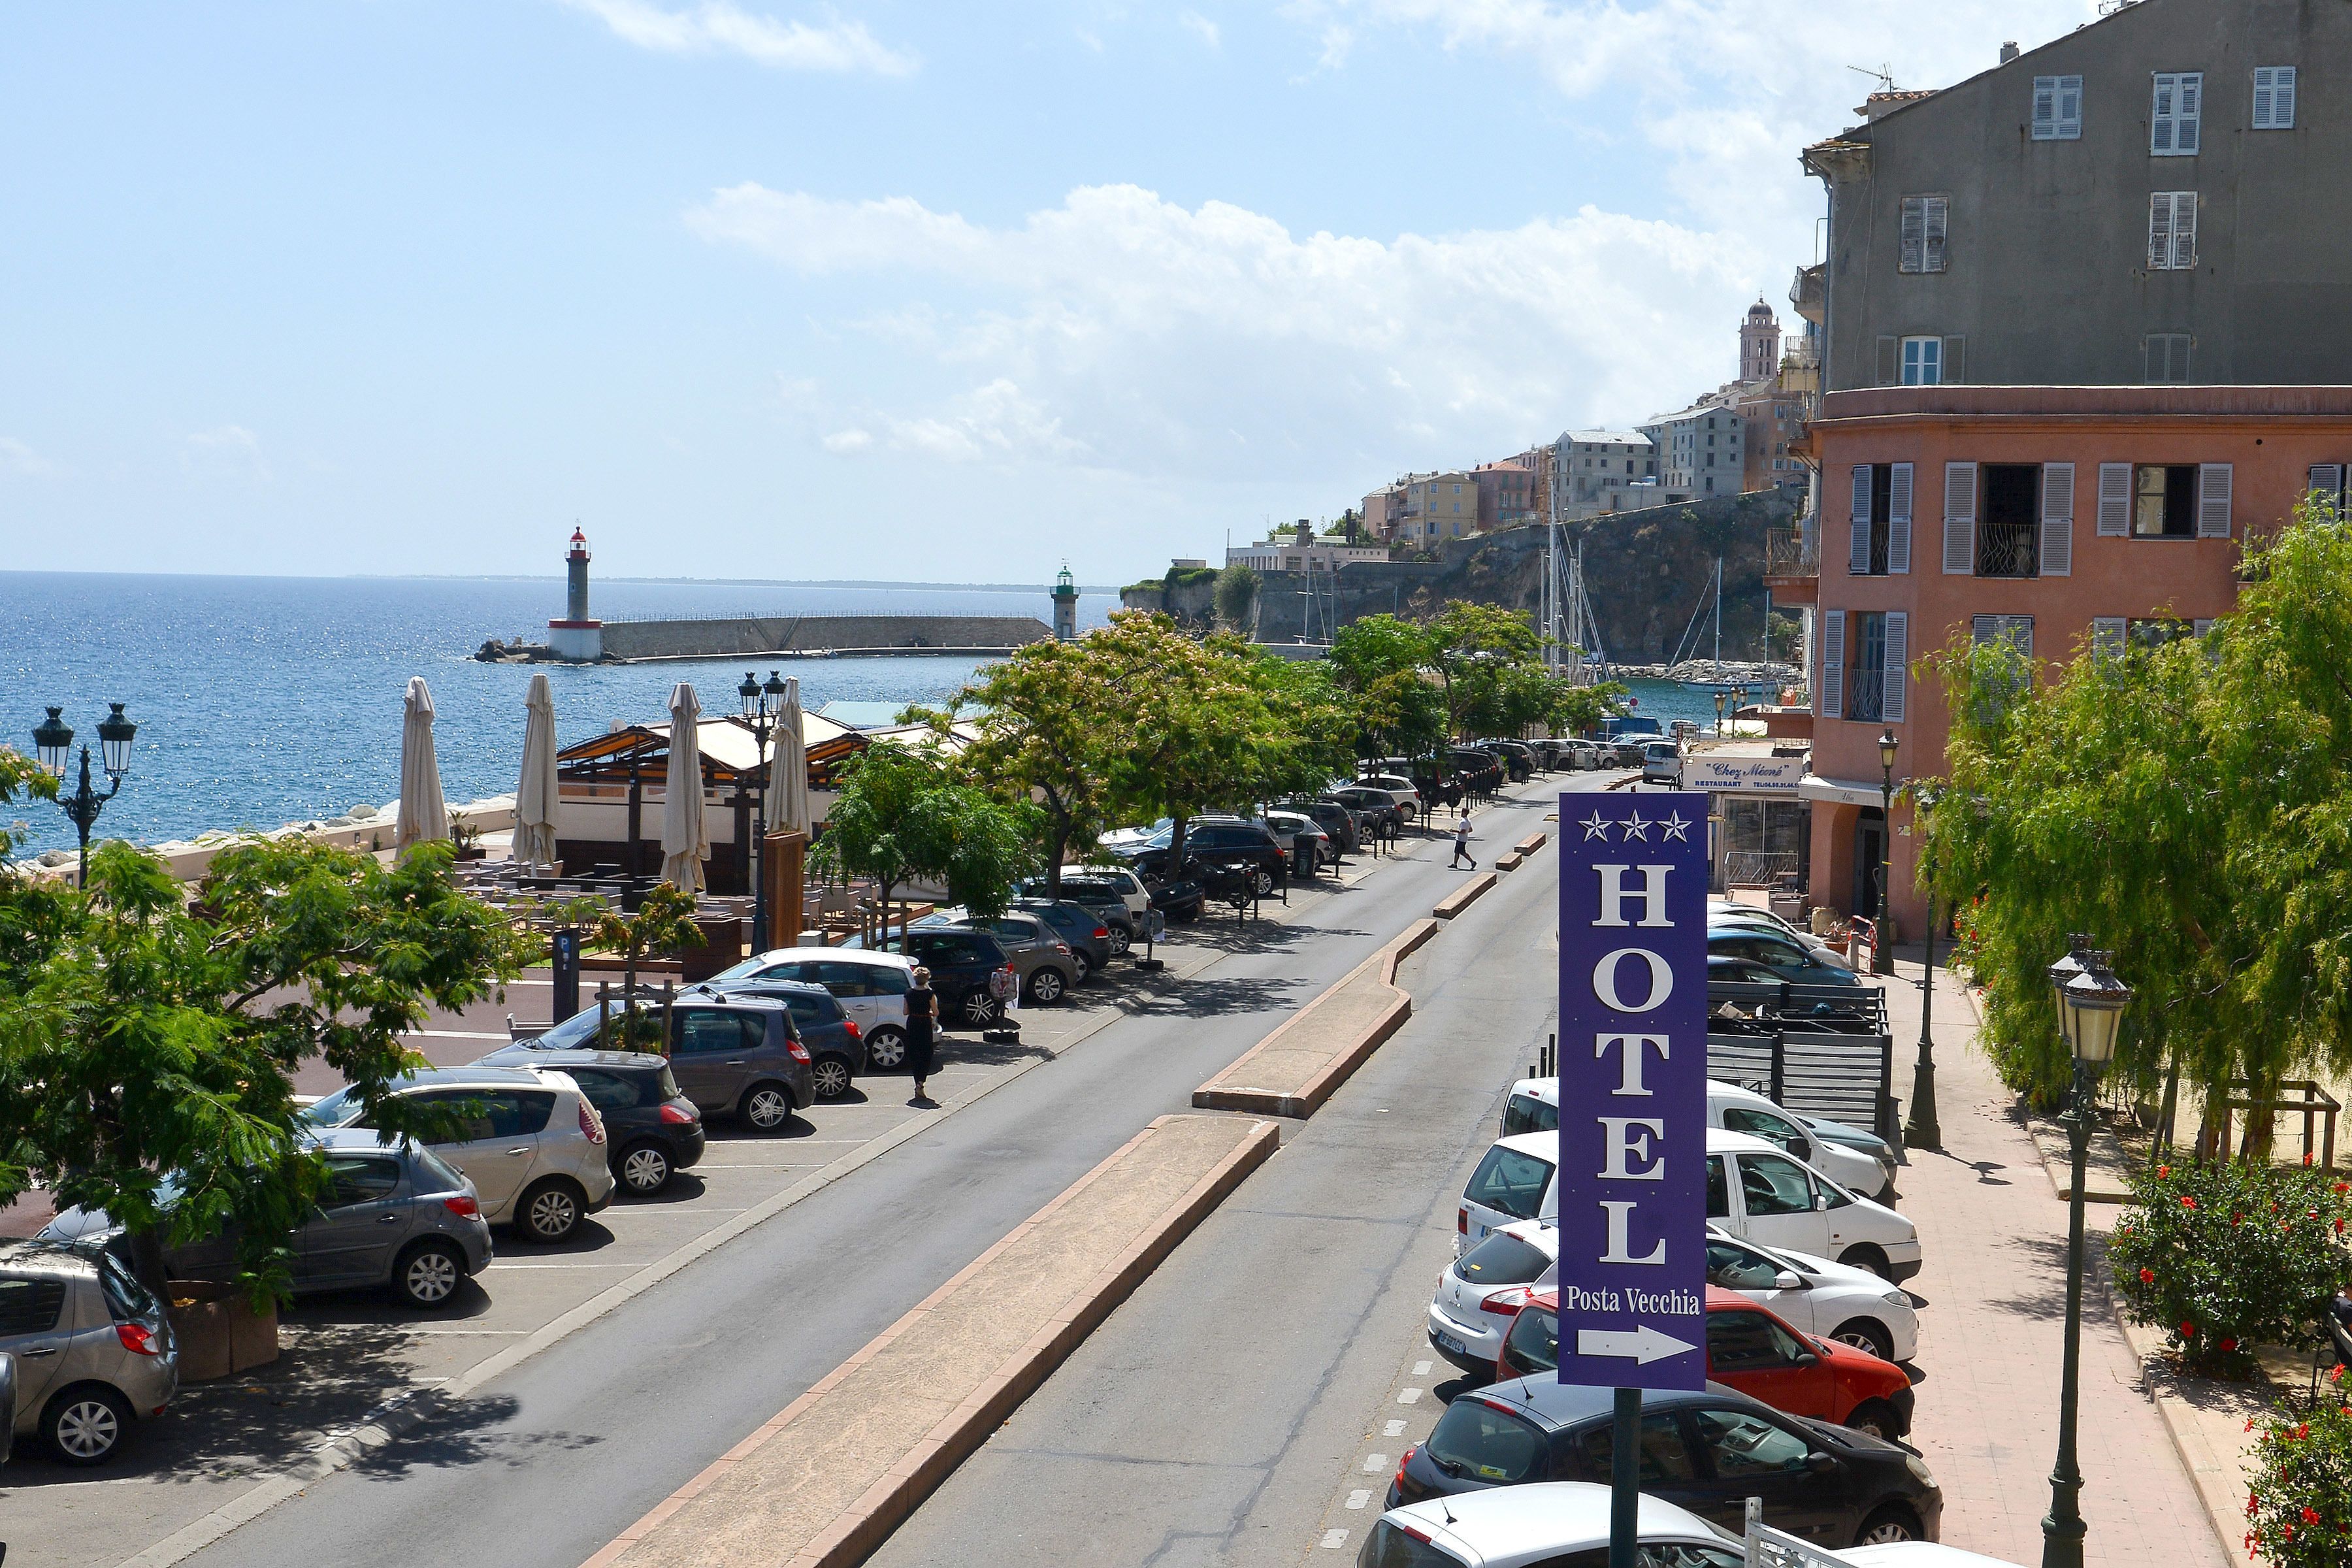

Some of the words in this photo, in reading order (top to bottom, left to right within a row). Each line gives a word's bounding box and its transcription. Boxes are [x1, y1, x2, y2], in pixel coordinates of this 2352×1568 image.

[1591, 864, 1676, 1265] HOTEL
[1567, 1285, 1621, 1313] Posta
[1624, 1288, 1701, 1316] Vecchia
